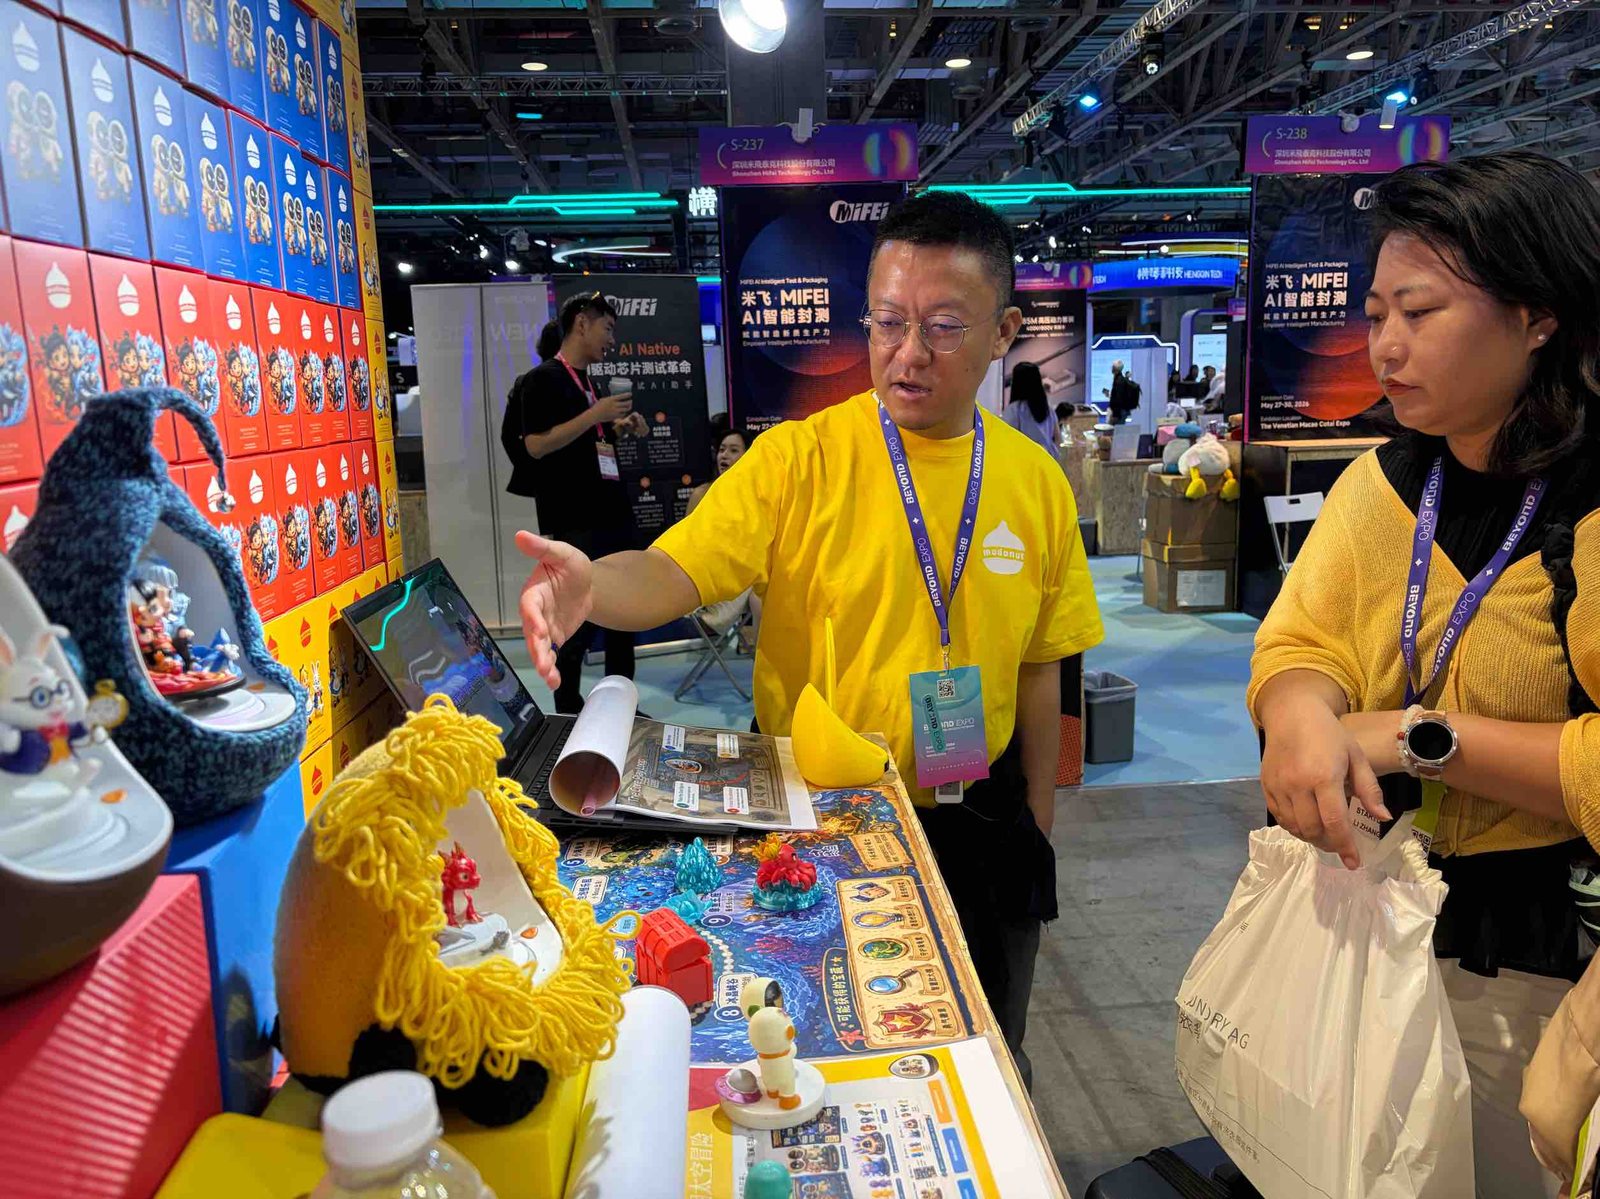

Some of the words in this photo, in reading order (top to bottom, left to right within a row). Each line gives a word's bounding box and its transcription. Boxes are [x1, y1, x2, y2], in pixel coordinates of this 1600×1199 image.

[731, 139, 763, 151] S-237
[1276, 128, 1307, 139] S-238
[1266, 274, 1294, 290] 米飞
[1302, 272, 1348, 289] MIFEI
[742, 291, 772, 306] 米飞
[780, 288, 829, 306] MIFEI
[1264, 290, 1347, 307] AI智能封测
[742, 308, 830, 325] AI智能封测
[619, 343, 632, 356] AI
[637, 342, 680, 356] Native
[889, 436, 903, 461] EXPO
[973, 439, 983, 479] BEYOND
[896, 463, 915, 504] BEYOND
[967, 481, 979, 506] EXPO
[1418, 510, 1434, 542] EXPO
[1502, 494, 1536, 552] BEYOND
[917, 537, 931, 563] EXPO
[953, 537, 969, 579] BEYOND
[924, 564, 942, 608] BEYOND
[1404, 584, 1420, 638] BEYOND
[1452, 591, 1476, 626] EXPO
[955, 717, 975, 726] EXPO
[1360, 823, 1382, 838] ZHANG
[830, 965, 852, 1022] 可能获得的宝藏
[721, 1009, 740, 1017] 8
